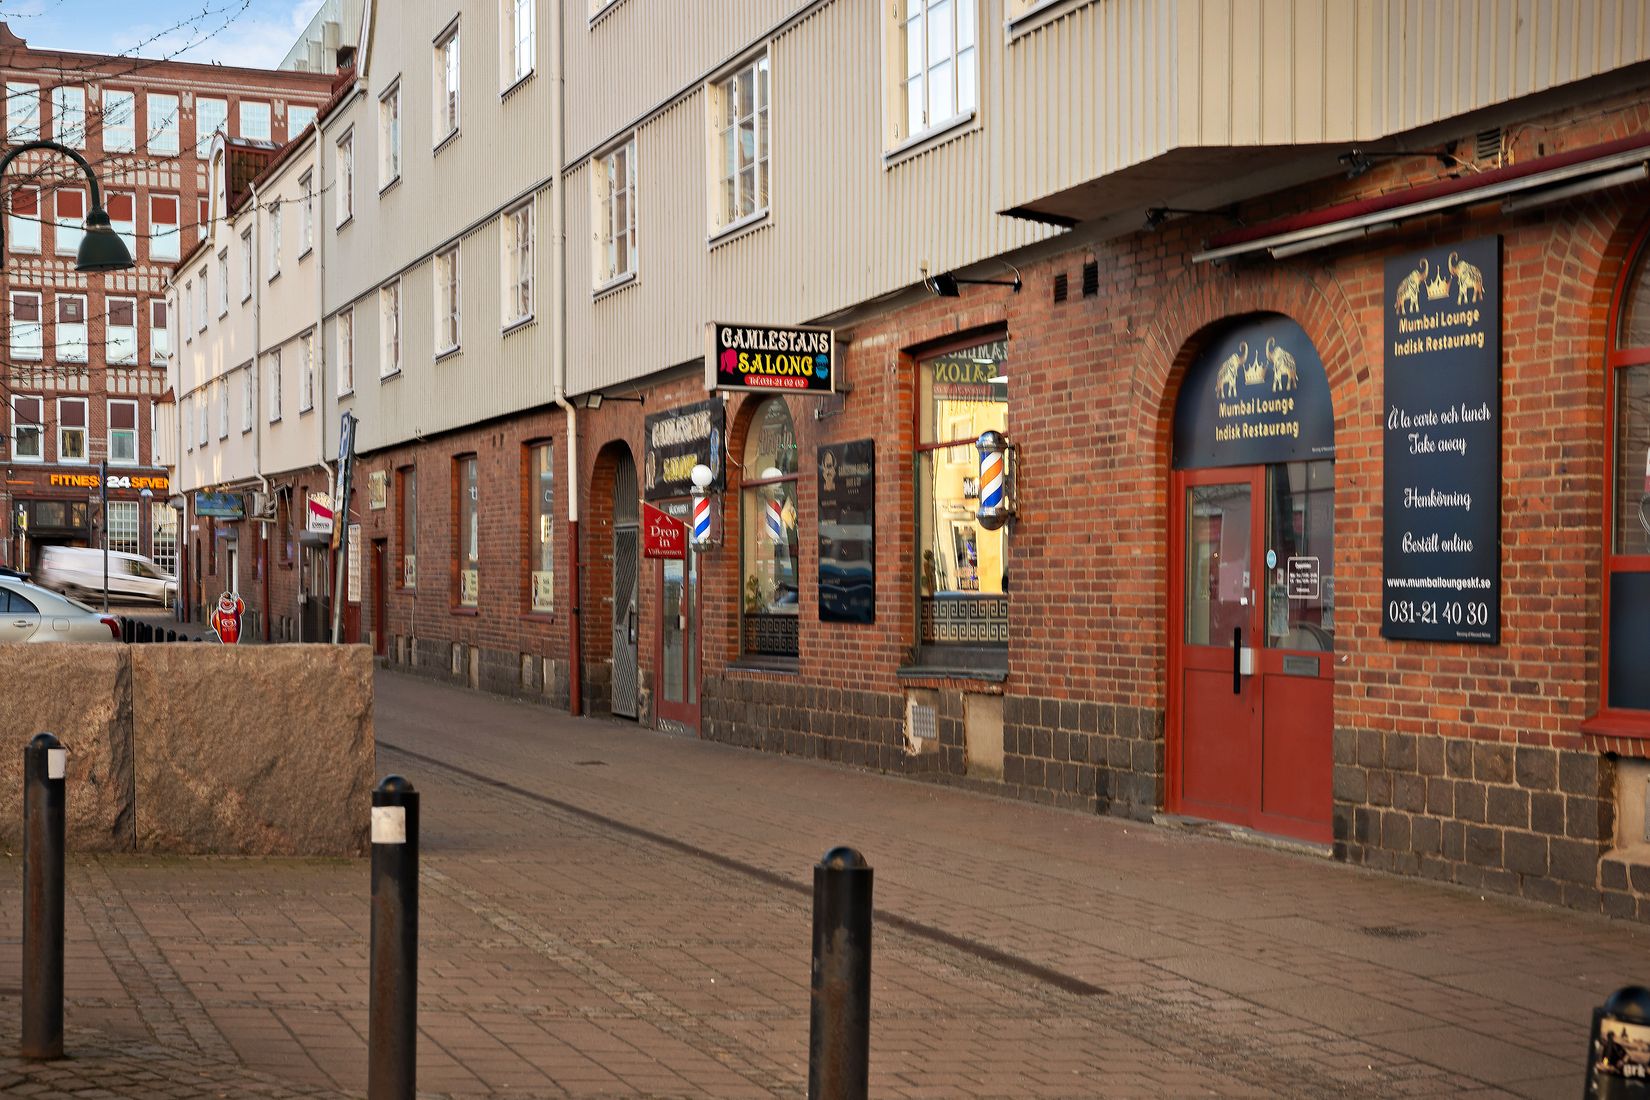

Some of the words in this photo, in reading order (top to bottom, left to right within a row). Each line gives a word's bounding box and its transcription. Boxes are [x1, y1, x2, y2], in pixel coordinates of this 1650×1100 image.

[1399, 312, 1439, 334] Mumbai
[1441, 309, 1480, 327] Lounge
[721, 327, 829, 353] GAMLESTANS
[1395, 337, 1424, 357] Indisk
[1426, 331, 1485, 352] Restaurang
[738, 352, 813, 376] SALONG
[1219, 398, 1255, 418] Mumbai
[1257, 397, 1295, 415] Lounge
[1400, 409, 1411, 428] la
[1414, 409, 1439, 427] carte
[1441, 405, 1459, 424] och
[1461, 402, 1491, 423] lunch
[1216, 424, 1241, 441] Indisk
[1242, 421, 1299, 438] Restaurang
[1408, 432, 1436, 455] Take
[1438, 438, 1467, 456] away
[1404, 486, 1472, 512] Hemkörning
[651, 525, 679, 539] Drop
[660, 537, 670, 547] in
[1402, 531, 1440, 553] Beställ
[1441, 532, 1473, 552] online
[1387, 577, 1491, 591] www.mumbailoungeskf.se
[1389, 600, 1438, 624] 031-21
[1442, 601, 1462, 625] 40
[1467, 602, 1488, 625] 30
